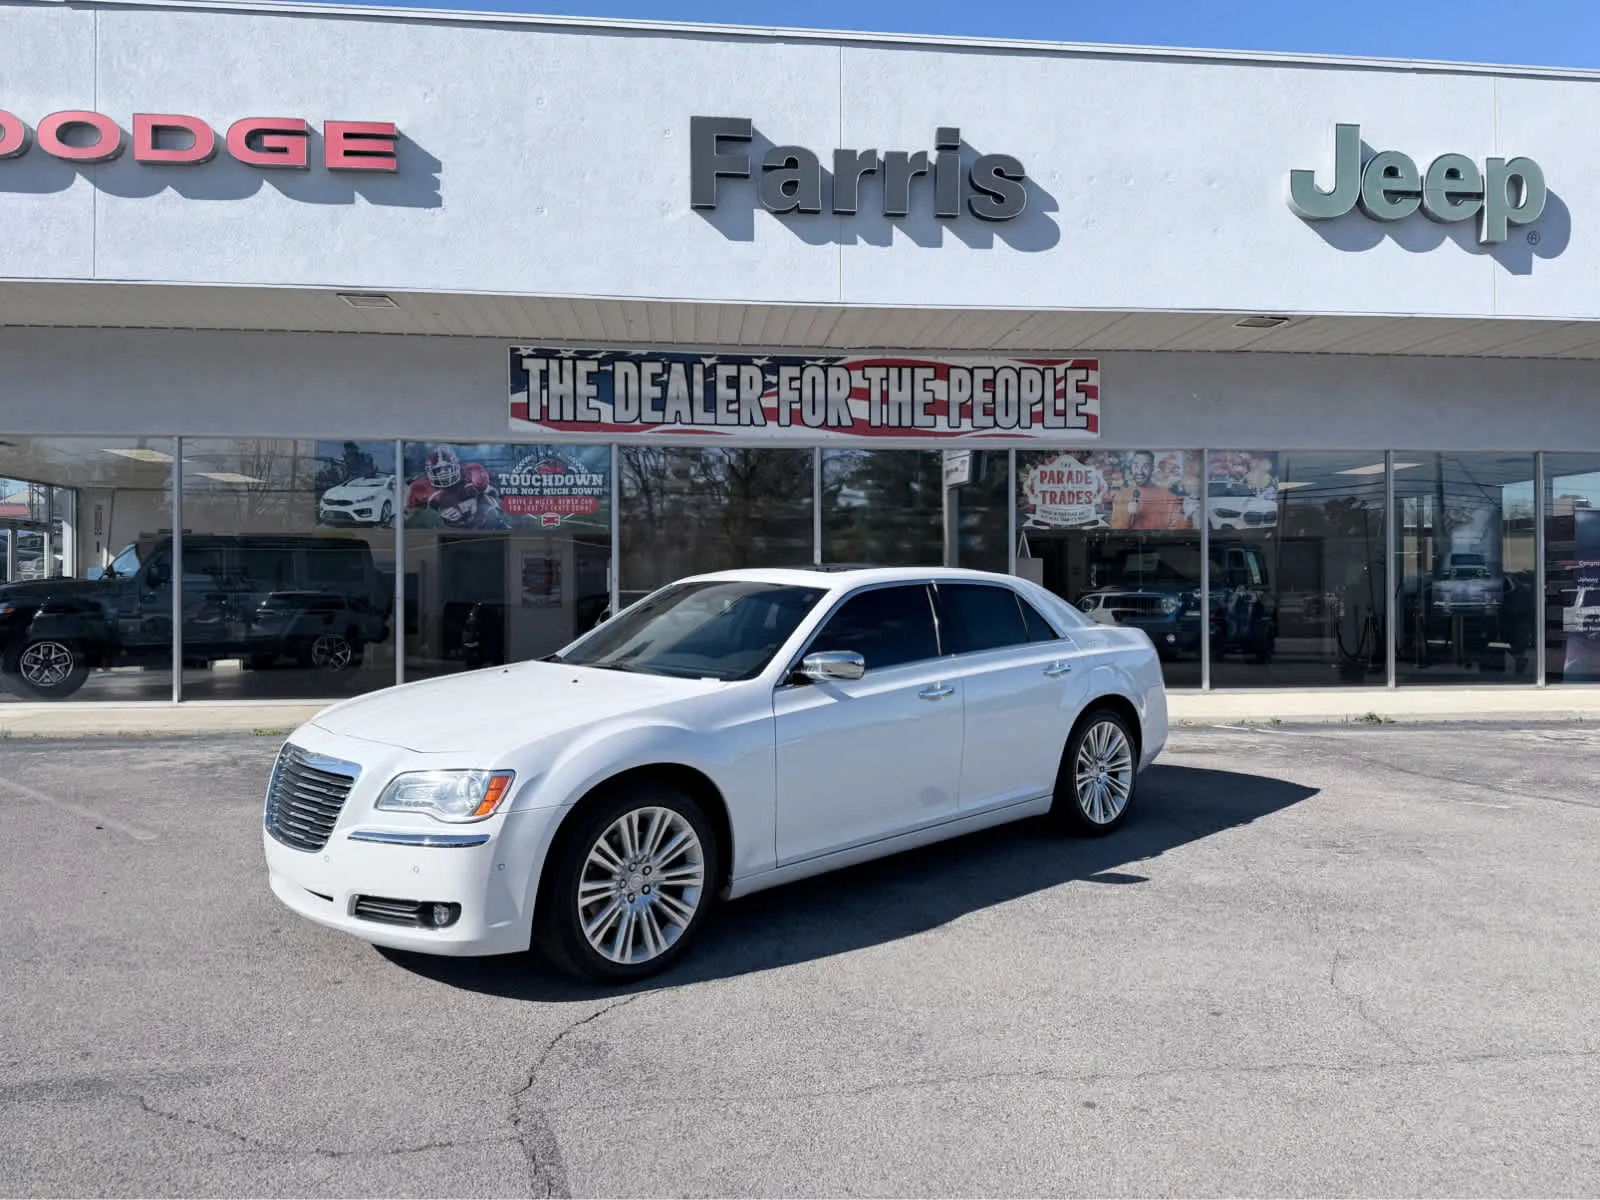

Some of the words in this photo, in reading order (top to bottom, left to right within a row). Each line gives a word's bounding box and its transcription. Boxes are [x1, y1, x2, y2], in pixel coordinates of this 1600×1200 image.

[690, 115, 1028, 221] Farris
[1288, 123, 1547, 245] Jeep
[521, 356, 600, 423] THE
[612, 361, 768, 427] DEALER
[777, 364, 854, 428] FOR
[863, 365, 936, 428] THE
[948, 366, 1088, 429] PEOPLE
[498, 474, 604, 486] TOUCHDOWN
[1039, 470, 1093, 485] PARADE
[500, 487, 518, 495] FOR
[520, 487, 541, 495] NOT
[543, 487, 569, 496] MUCH
[571, 487, 603, 496] DOWN!
[1039, 490, 1093, 505] TRADES
